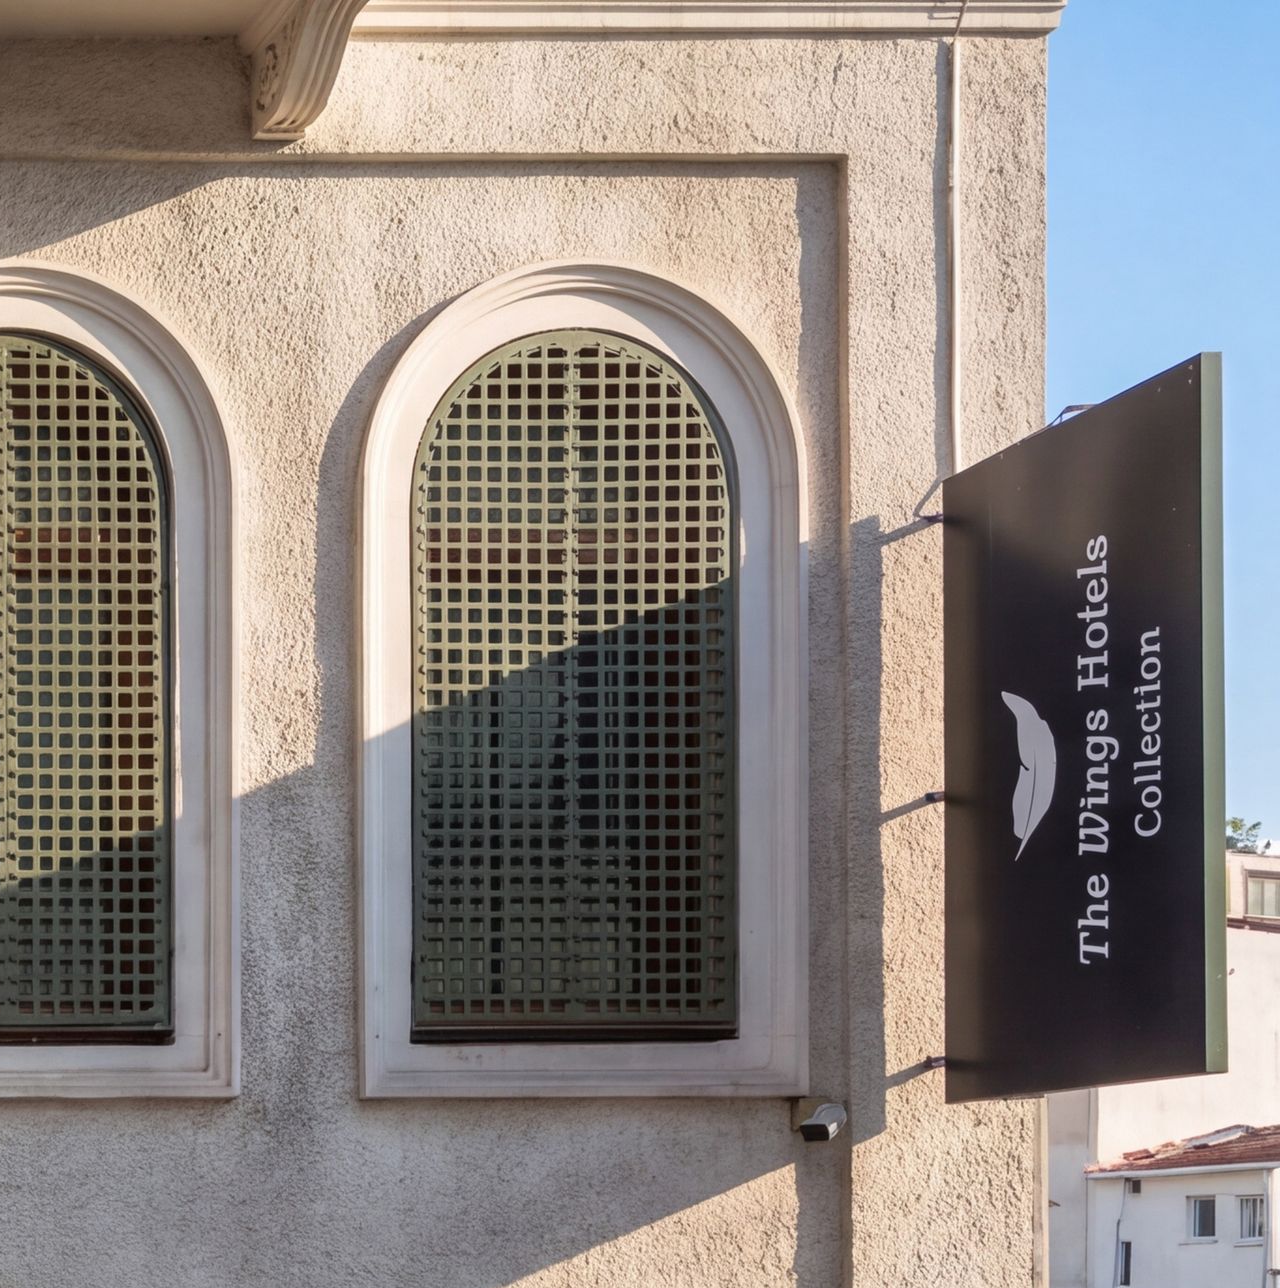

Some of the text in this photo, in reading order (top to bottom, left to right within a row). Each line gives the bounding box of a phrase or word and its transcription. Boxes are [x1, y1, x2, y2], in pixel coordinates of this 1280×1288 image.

[1076, 533, 1120, 966] The Wings Hotels
[1133, 625, 1162, 838] Collection
